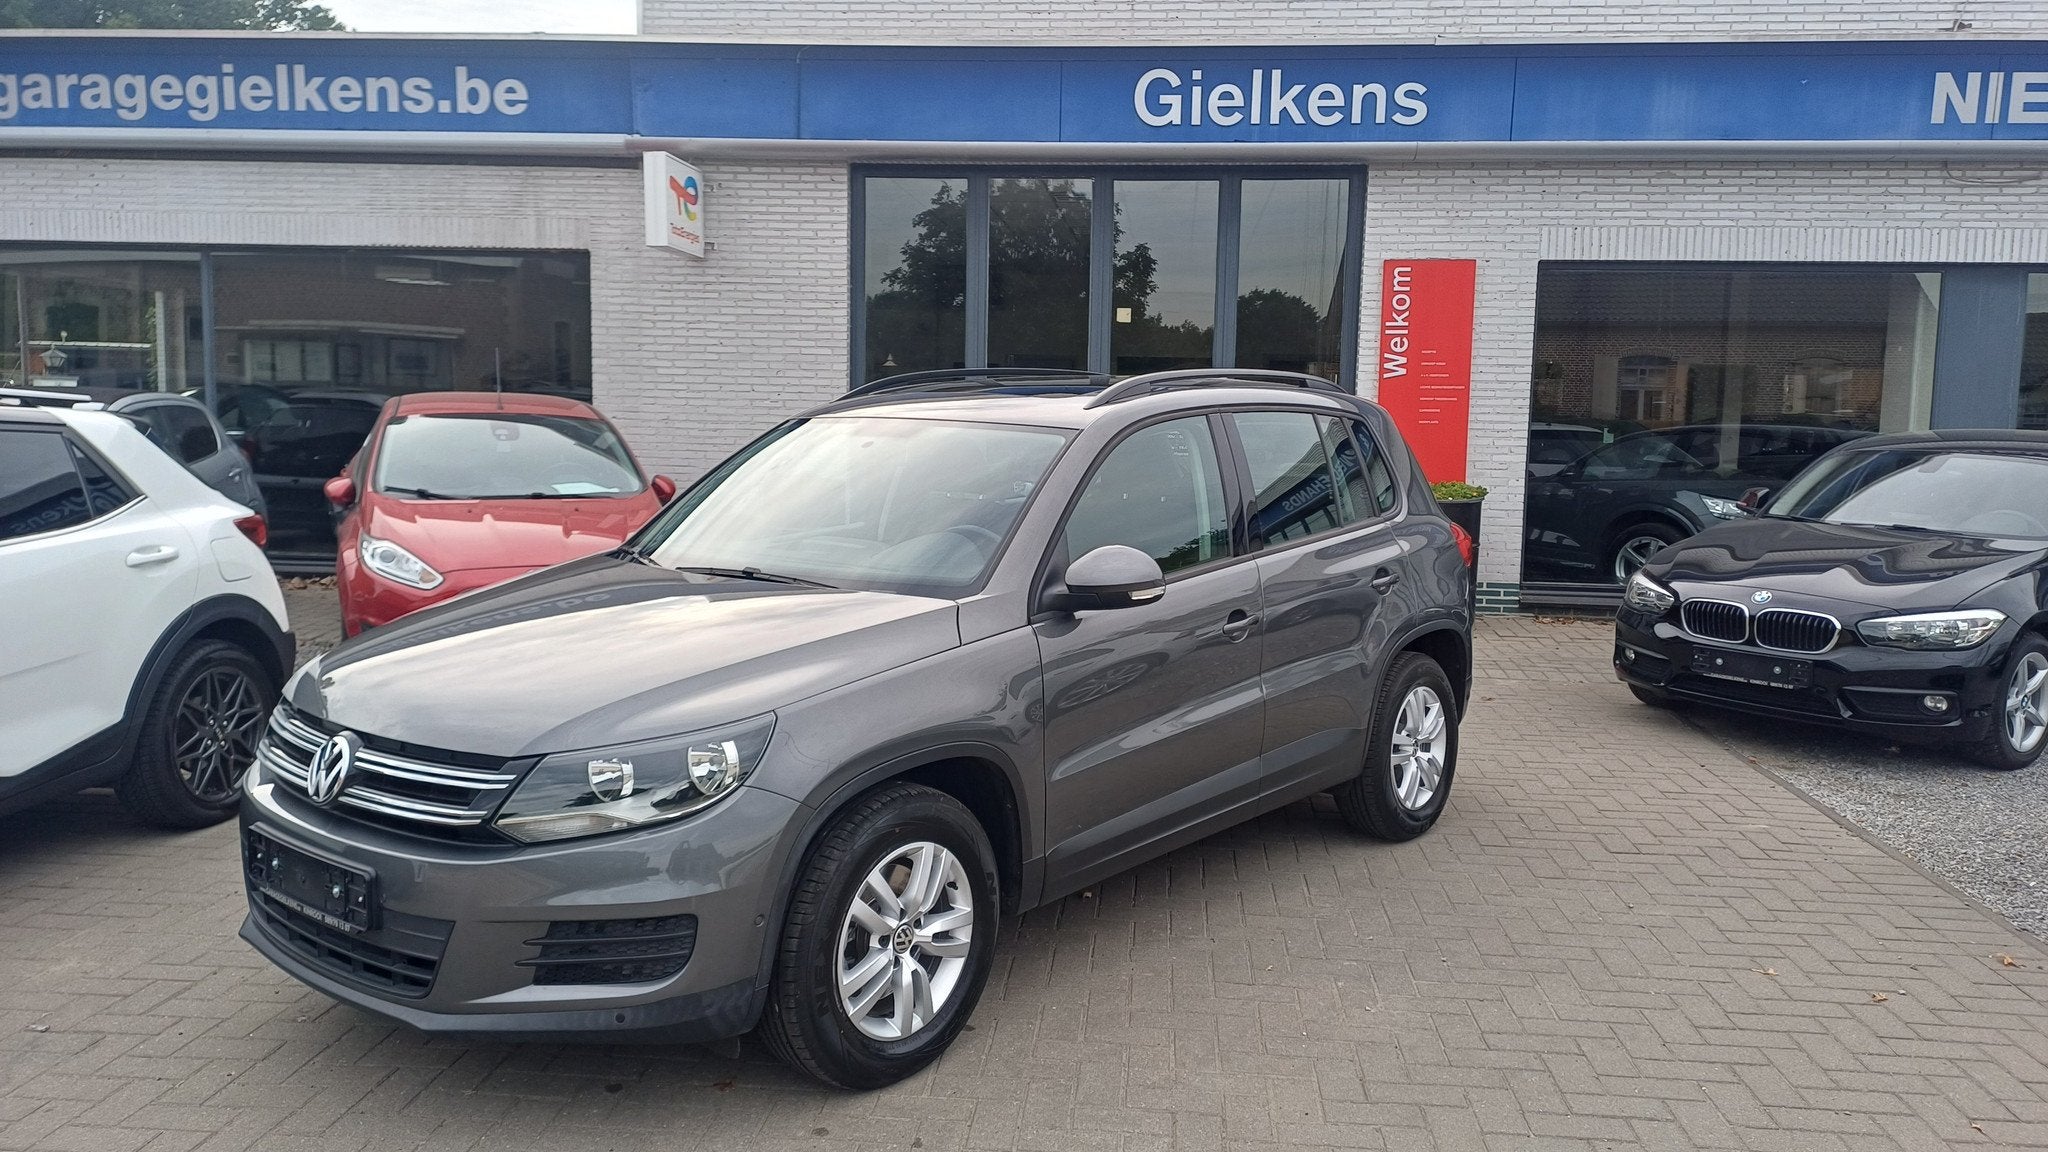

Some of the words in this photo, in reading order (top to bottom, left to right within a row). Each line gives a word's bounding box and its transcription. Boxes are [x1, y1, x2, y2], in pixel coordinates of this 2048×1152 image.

[0, 64, 528, 121] garagegielkens.be
[1134, 68, 1429, 126] Gielkens
[1930, 72, 2048, 124] NIE
[1383, 266, 1412, 379] Welkom
